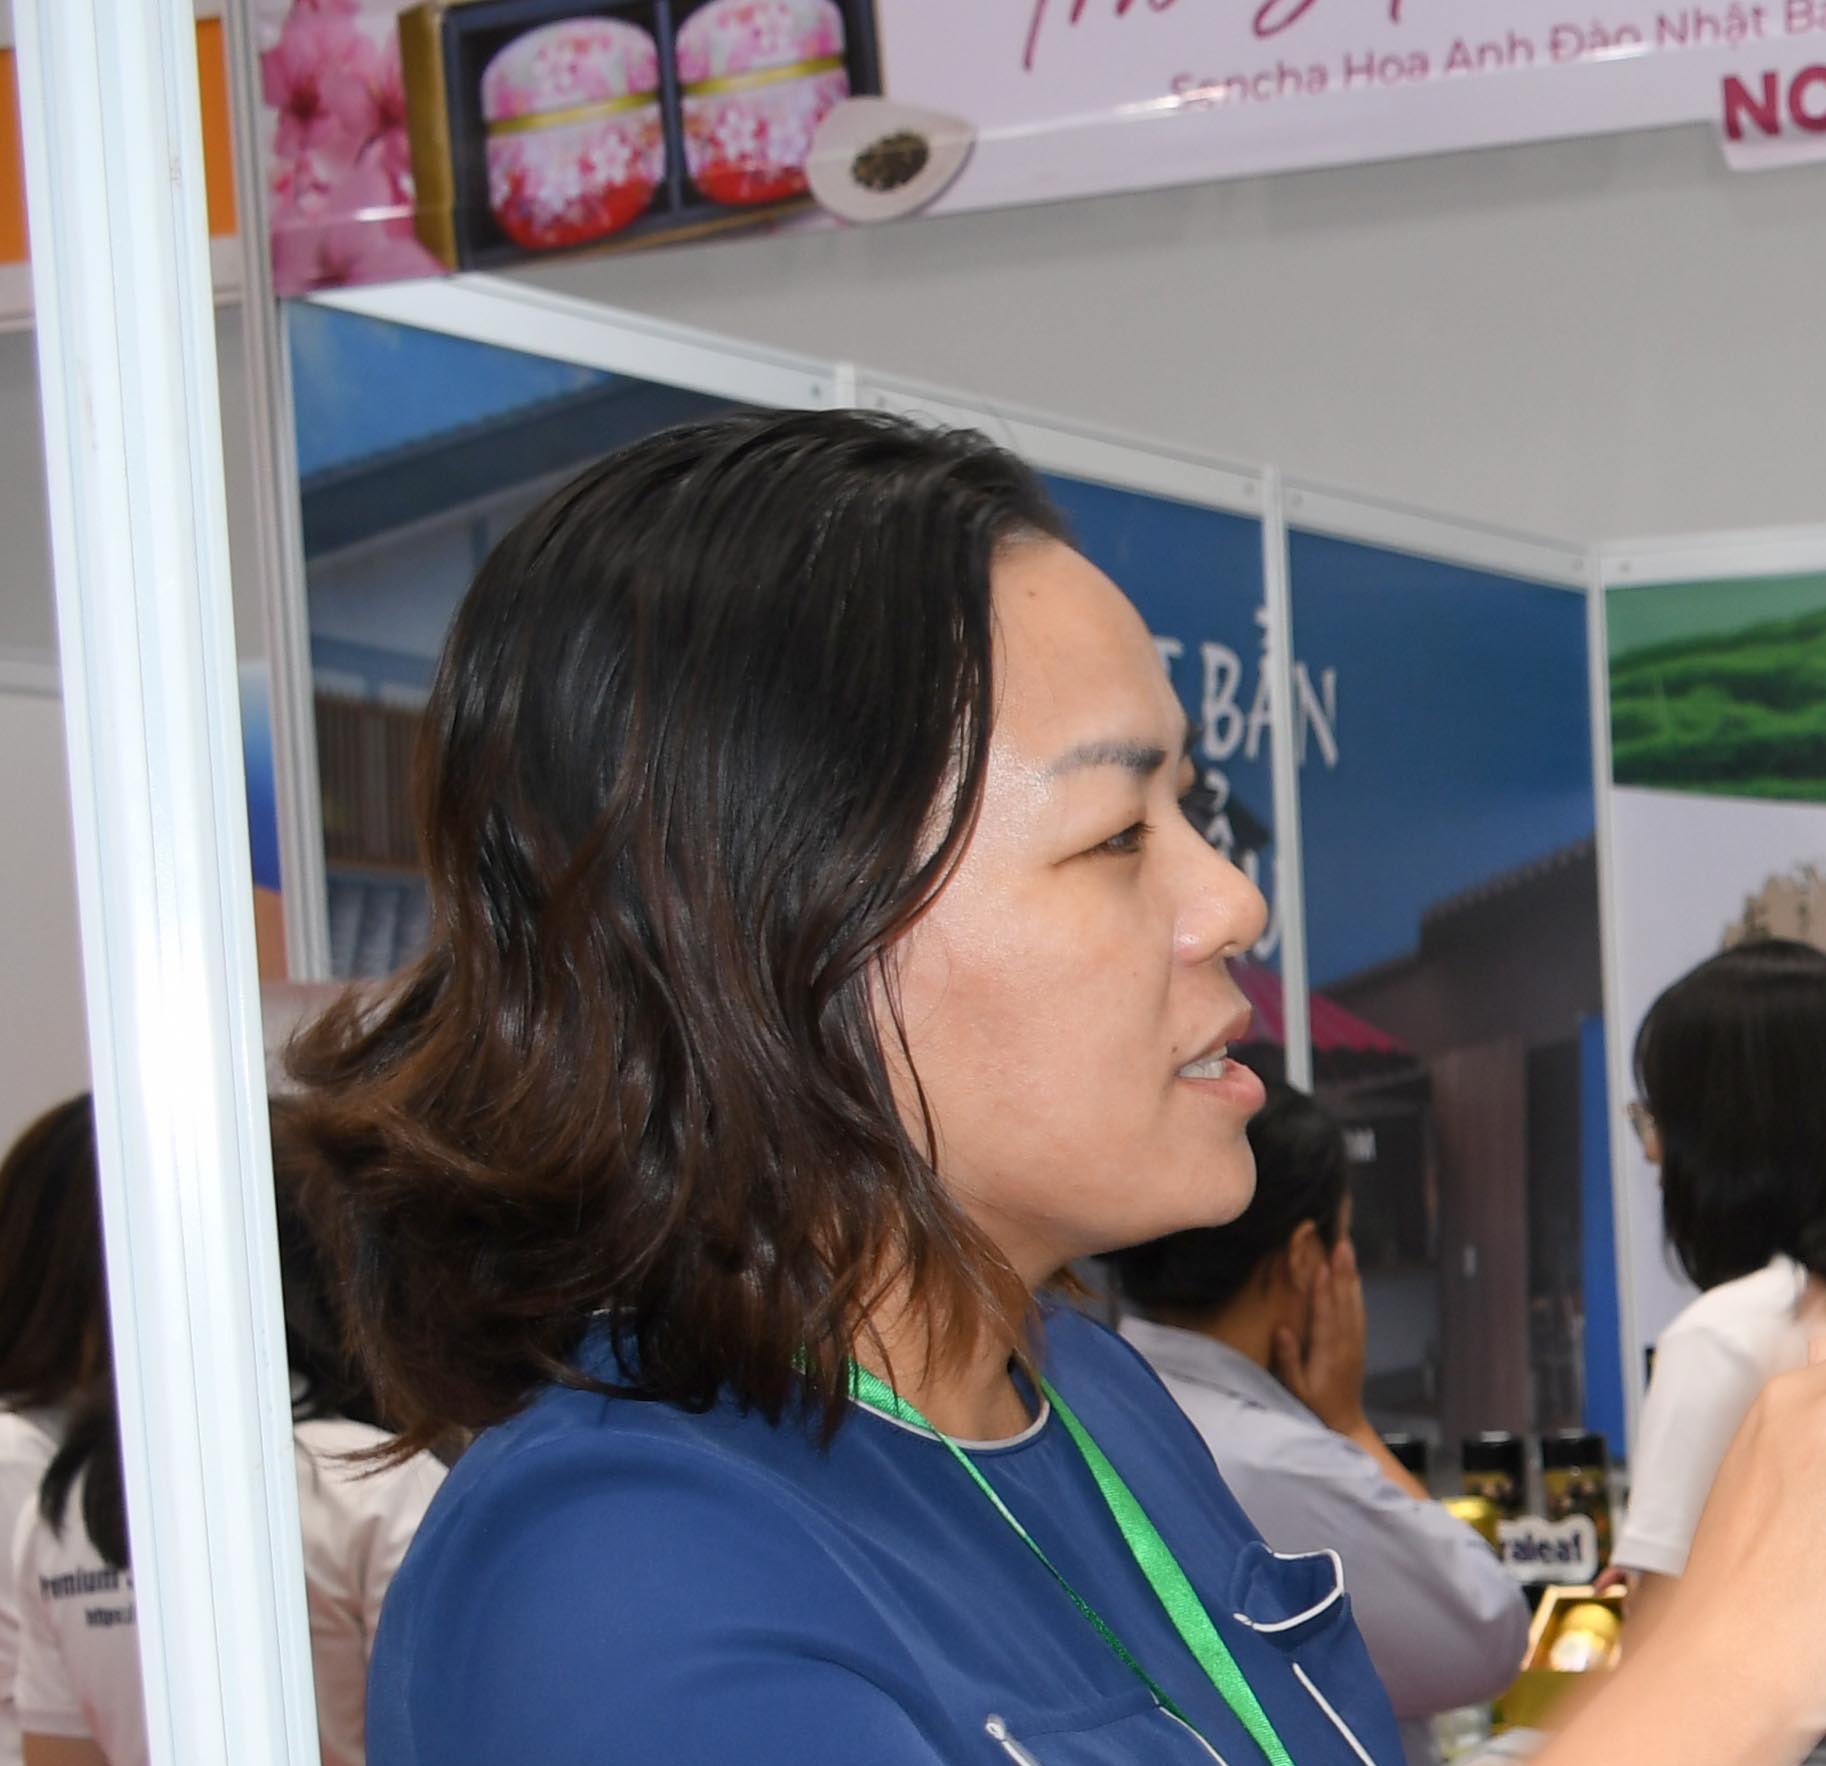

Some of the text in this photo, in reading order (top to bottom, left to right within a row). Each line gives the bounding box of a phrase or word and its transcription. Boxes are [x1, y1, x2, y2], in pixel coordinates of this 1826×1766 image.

[1169, 60, 1328, 111] Sencha
[1343, 48, 1431, 90] Hoa
[1443, 33, 1535, 74] Anh
[1548, 22, 1643, 62] Đào
[1655, 8, 1767, 49] Nhật
